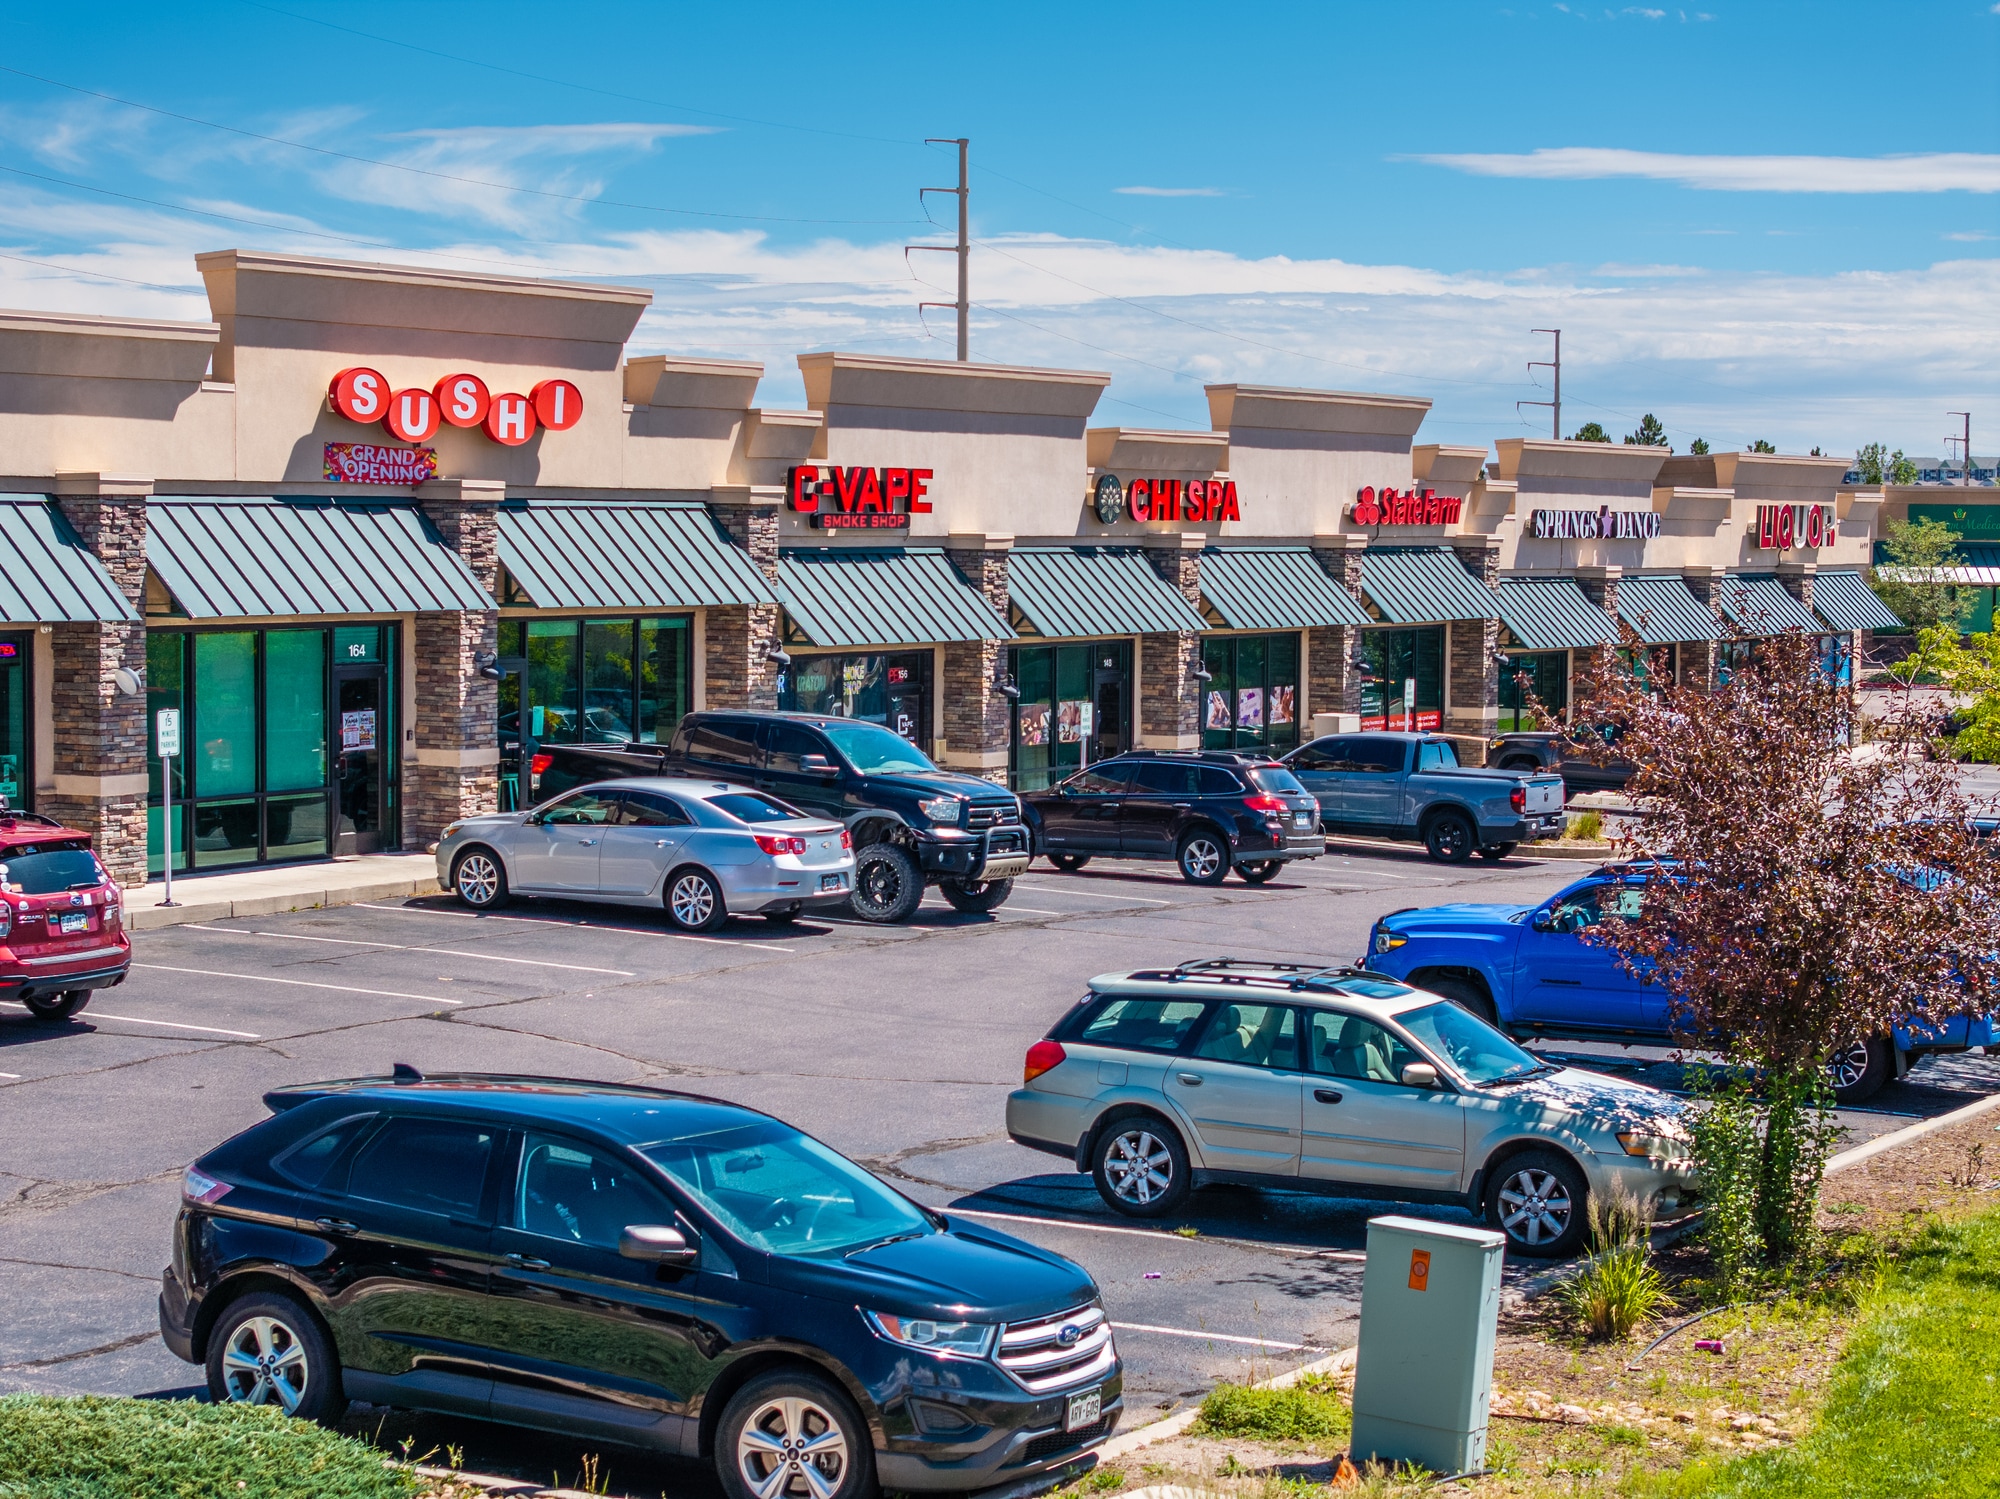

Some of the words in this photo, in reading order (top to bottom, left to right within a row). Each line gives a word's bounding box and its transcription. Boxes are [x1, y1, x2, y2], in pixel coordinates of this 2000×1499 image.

[351, 374, 565, 439] SUSHI
[351, 444, 416, 466] GRAND
[344, 459, 425, 481] OPENING
[793, 464, 934, 514] C-VAPE
[1128, 478, 1181, 523] CHI
[1185, 479, 1241, 523] SPA
[823, 515, 867, 528] SMOKE
[871, 516, 906, 529] SHOP
[1535, 509, 1598, 540] SPRINGS
[1615, 511, 1661, 540] DANCE
[1758, 503, 1836, 551] LIQUOR
[348, 644, 366, 657] 164
[898, 669, 908, 679] 156
[164, 717, 173, 727] 15
